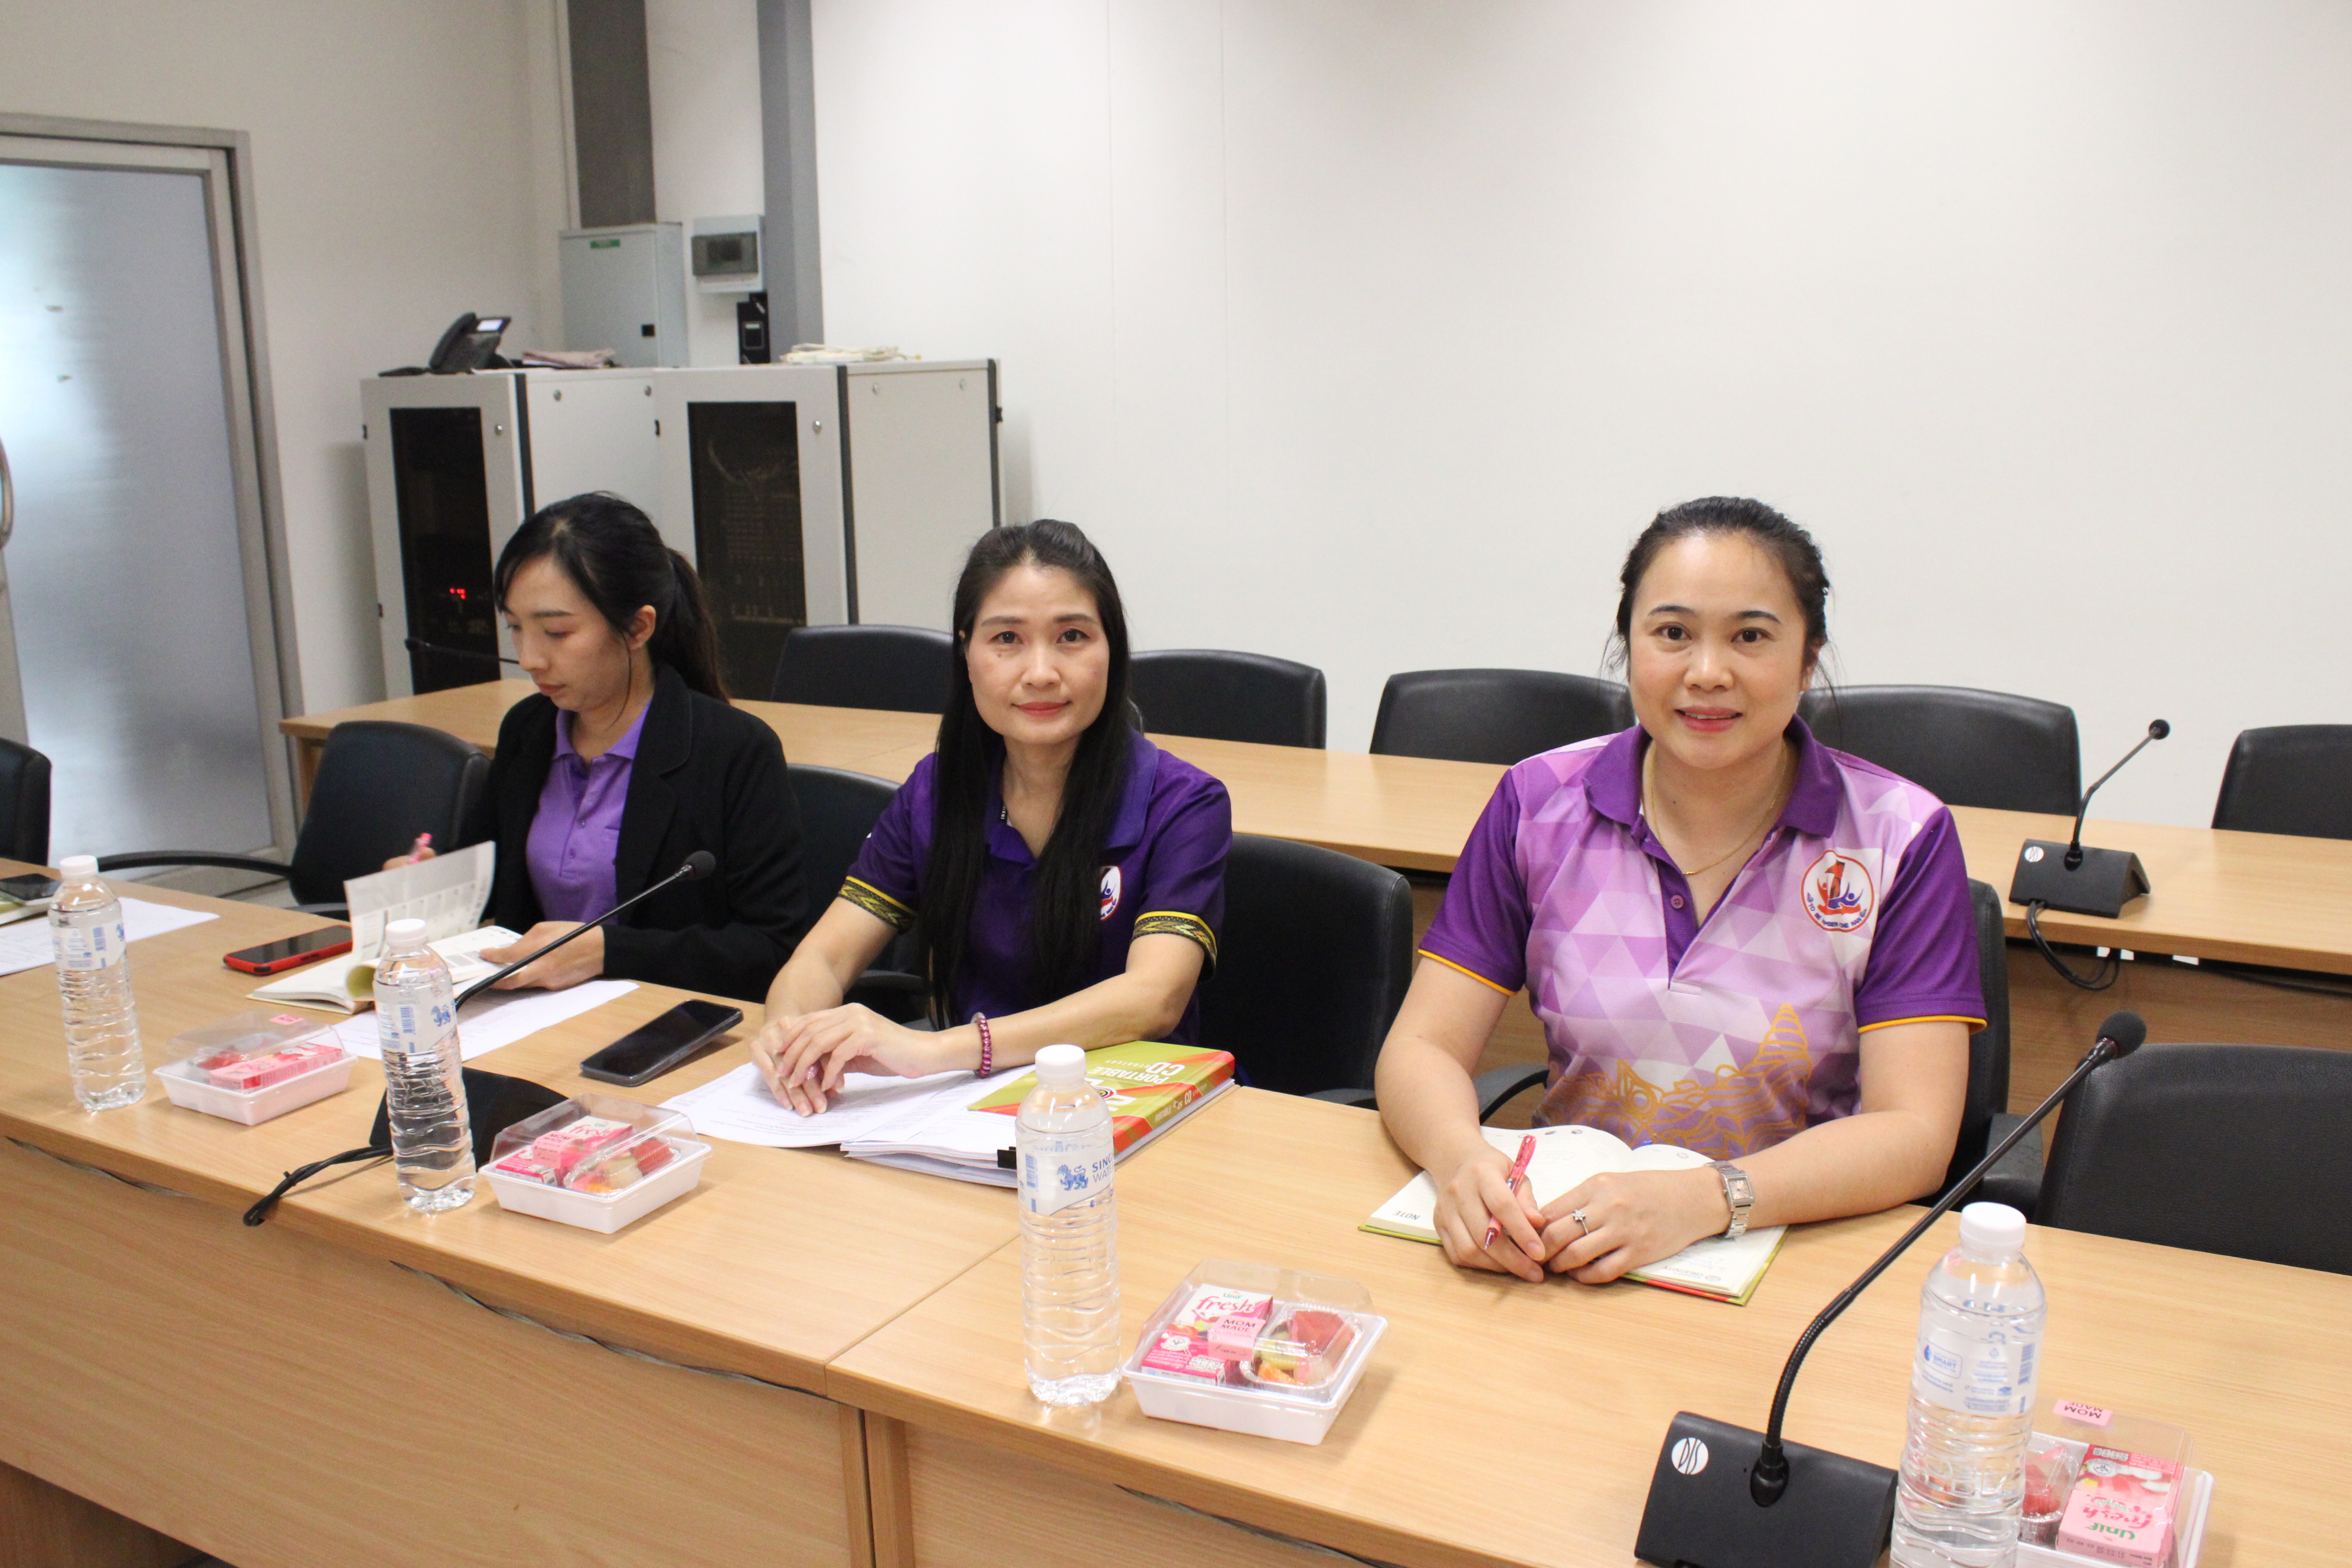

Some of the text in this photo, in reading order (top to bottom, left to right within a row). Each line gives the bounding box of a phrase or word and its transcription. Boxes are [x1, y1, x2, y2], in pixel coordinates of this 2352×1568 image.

[1809, 903, 1815, 912] TO
[1105, 1059, 1185, 1076] CD STRATEGY
[1088, 1066, 1171, 1084] PORTABLE
[1155, 1105, 1172, 1123] PORTABLE
[1184, 1090, 1192, 1105] CD
[1393, 1210, 1420, 1220] NOTE
[1665, 1266, 1704, 1277] CREATIVITY
[1196, 1296, 1255, 1314] fresh
[1221, 1324, 1249, 1332] MADE
[1224, 1318, 1256, 1328] MOM
[1933, 1354, 1957, 1368] SMART
[2064, 1405, 2102, 1419] MOM
[2082, 1506, 2152, 1529] fresh
[2085, 1523, 2136, 1540] Unif
